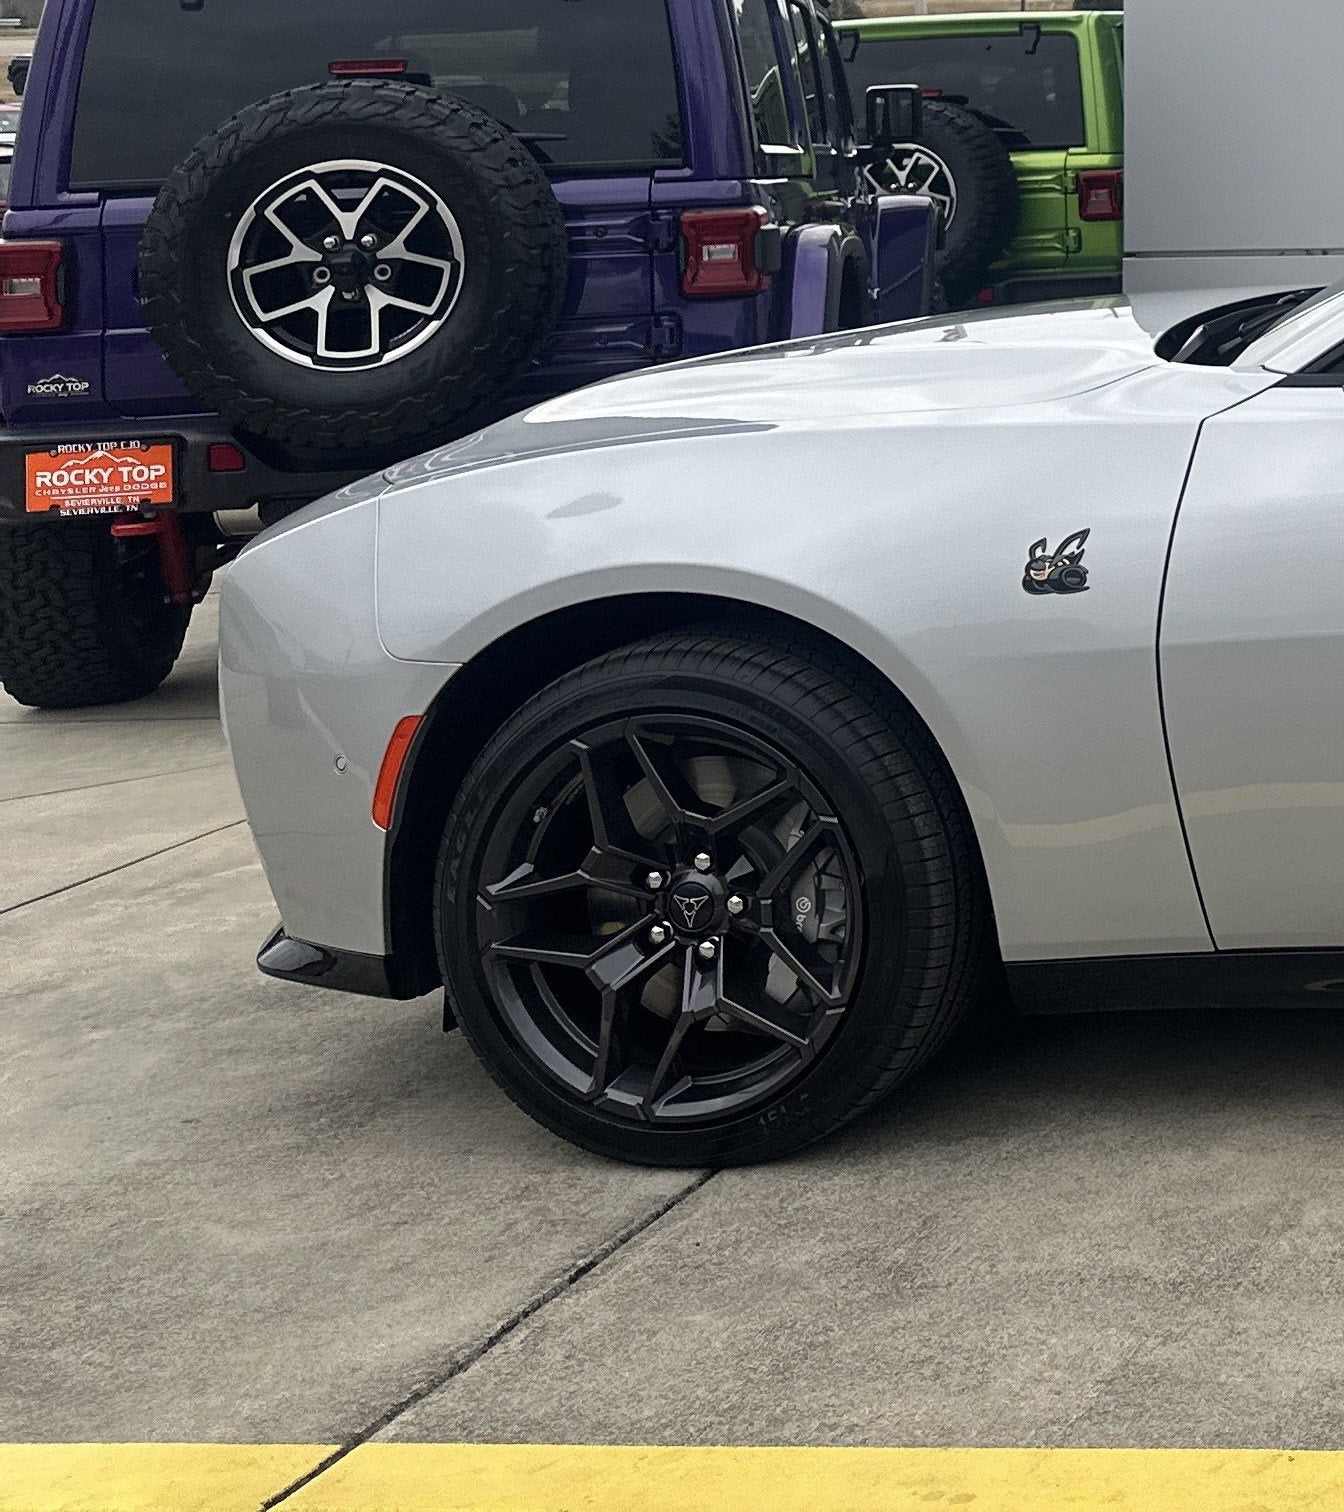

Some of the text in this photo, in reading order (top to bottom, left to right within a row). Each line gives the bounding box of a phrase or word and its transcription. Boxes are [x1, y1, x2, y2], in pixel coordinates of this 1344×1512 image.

[27, 381, 90, 393] ROCKY TOP
[57, 442, 93, 454] ROCKY
[97, 441, 118, 452] TOP
[35, 464, 166, 488] ROCKY TOP
[35, 481, 168, 497] CHRYSLER Jeep DODGE
[127, 495, 140, 504] TN
[125, 504, 139, 512] TN
